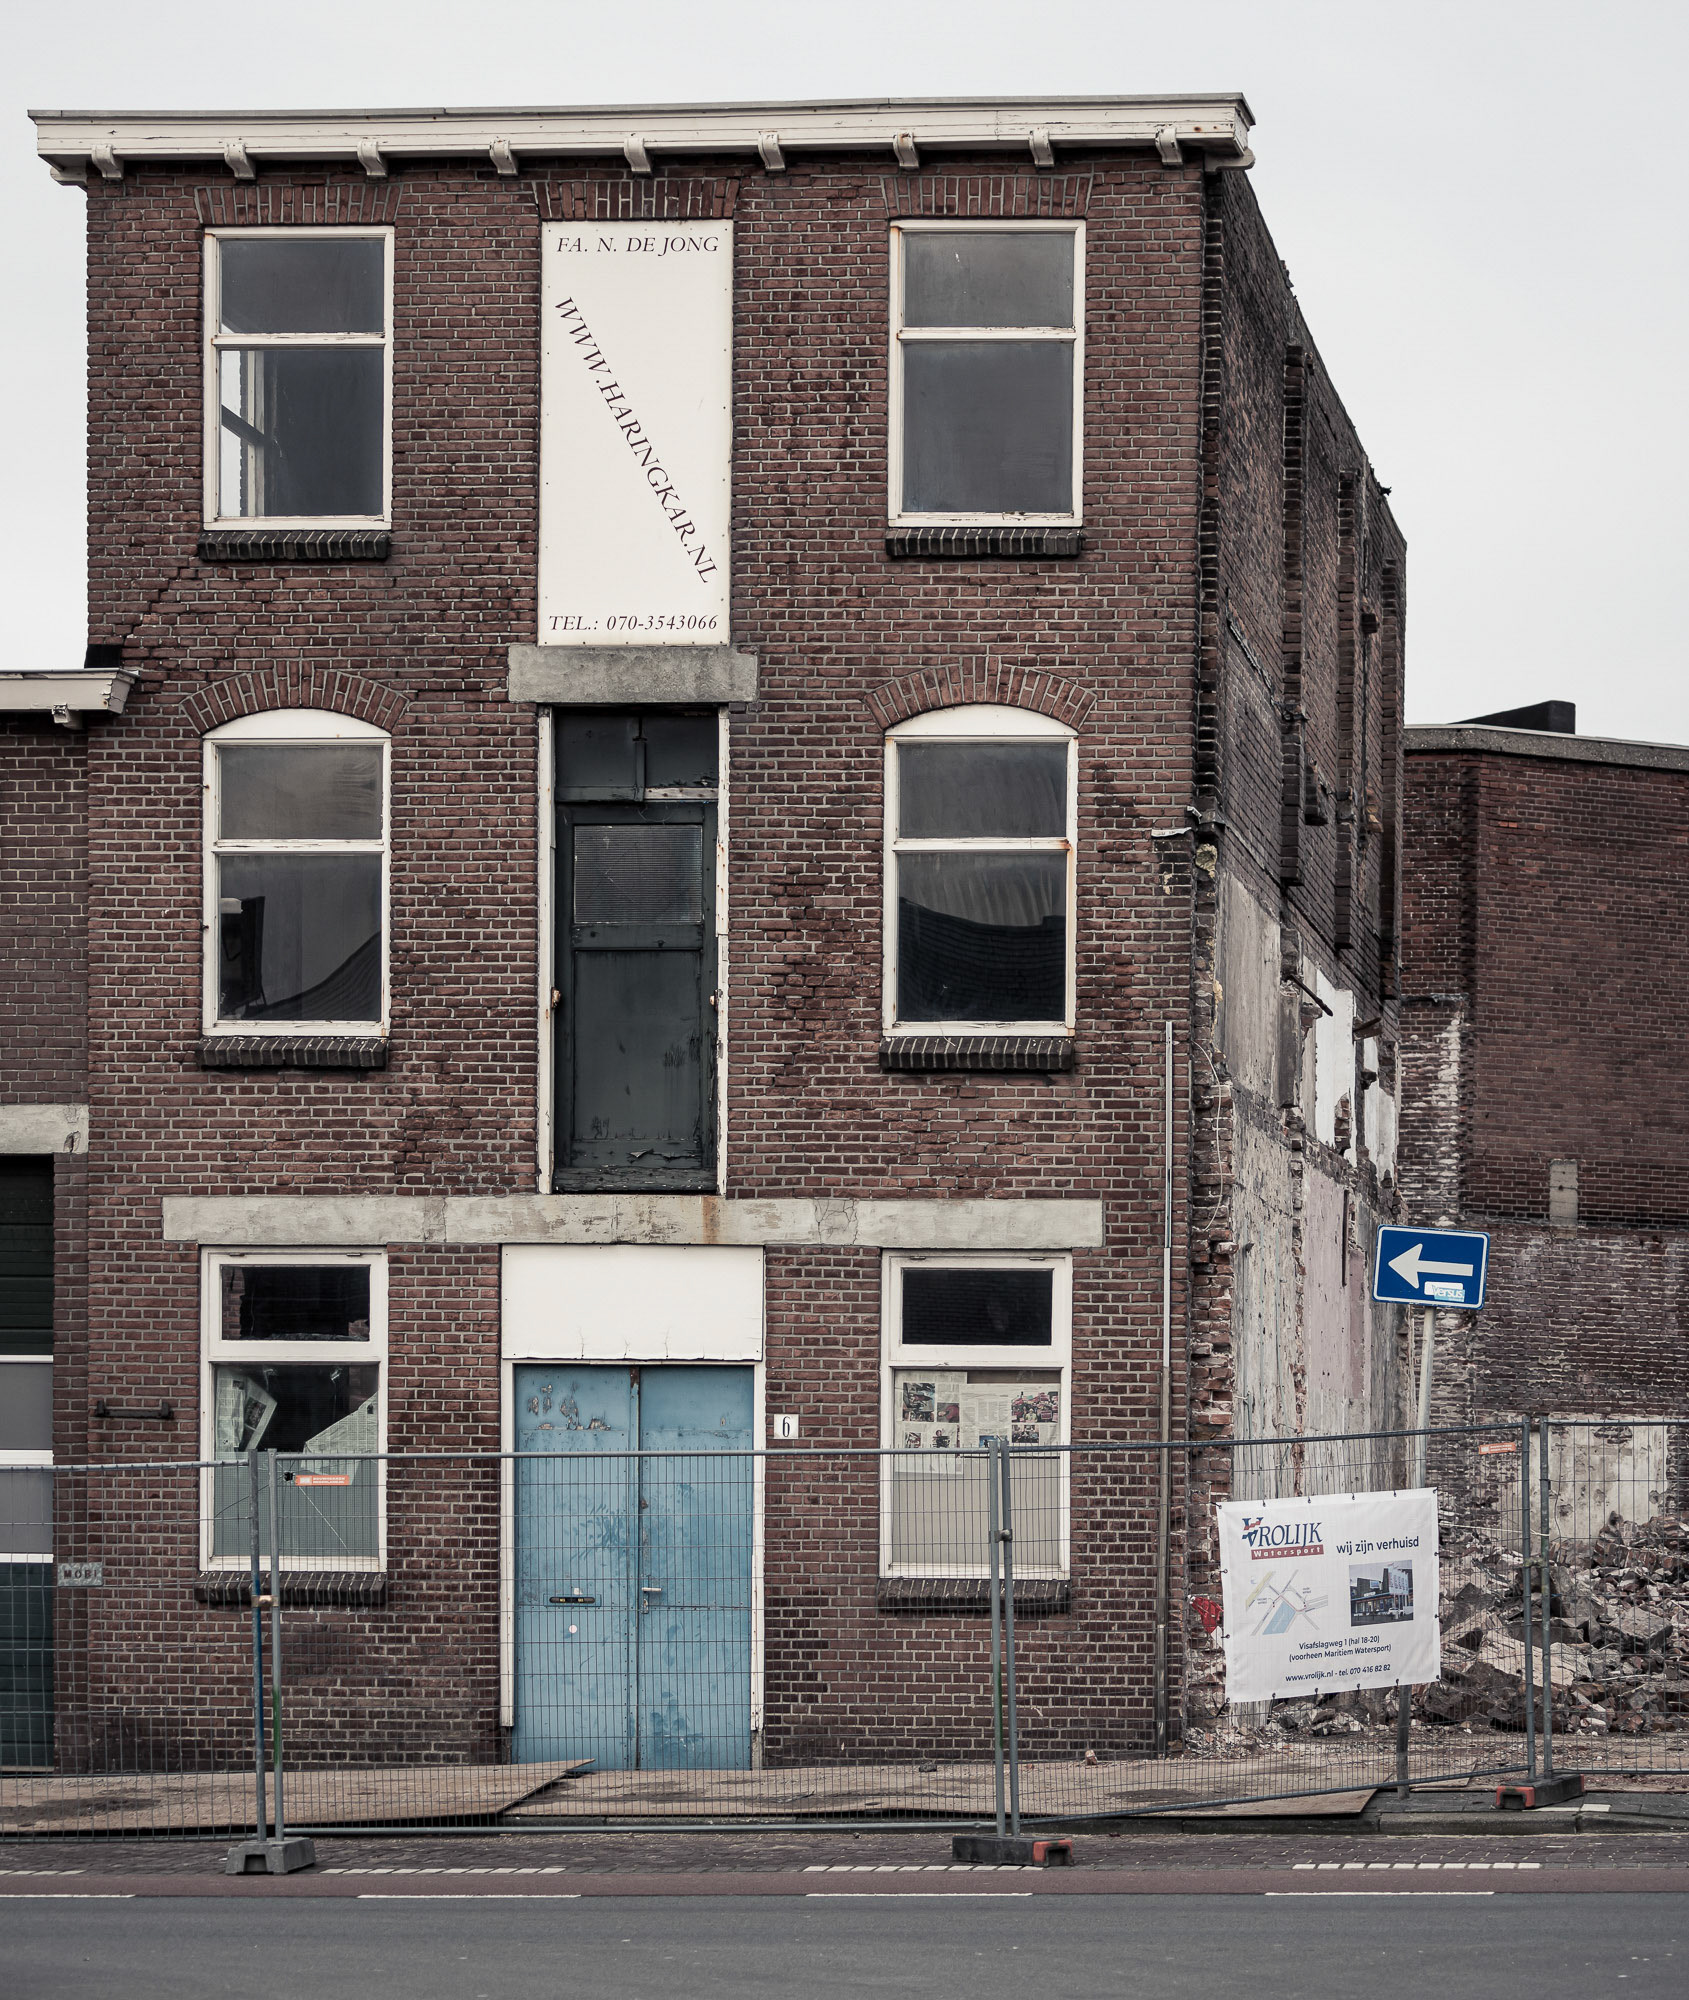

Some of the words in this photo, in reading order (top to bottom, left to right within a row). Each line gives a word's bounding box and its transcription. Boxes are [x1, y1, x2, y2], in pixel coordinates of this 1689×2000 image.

[558, 237, 588, 253] FA.
[597, 237, 617, 253] N.
[626, 237, 656, 252] DE
[657, 236, 719, 257] JONG
[554, 296, 718, 584] WWW.HARINGKAR.NL
[549, 615, 599, 631] TEL.:
[606, 614, 719, 631] 070-3543066
[782, 1416, 791, 1438] 6
[1242, 1517, 1323, 1548] VROLIJK
[1253, 1547, 1321, 1558] Watersport
[1336, 1541, 1353, 1556] wij
[1355, 1538, 1374, 1554] zijn
[1376, 1536, 1419, 1551] verhuisd
[1299, 1639, 1343, 1650] Visafslagweg
[1348, 1637, 1360, 1647] (hal
[1361, 1635, 1380, 1644] 18-20)
[1289, 1651, 1322, 1662] (voorheen
[1324, 1649, 1353, 1658] Maritiem
[1354, 1644, 1392, 1655] Watersport)
[1285, 1670, 1333, 1682] www.vrolijk.nl
[1338, 1668, 1348, 1676] tel.
[1349, 1666, 1361, 1675] 070
[1374, 1664, 1382, 1672] 82
[1383, 1663, 1391, 1671] 82
